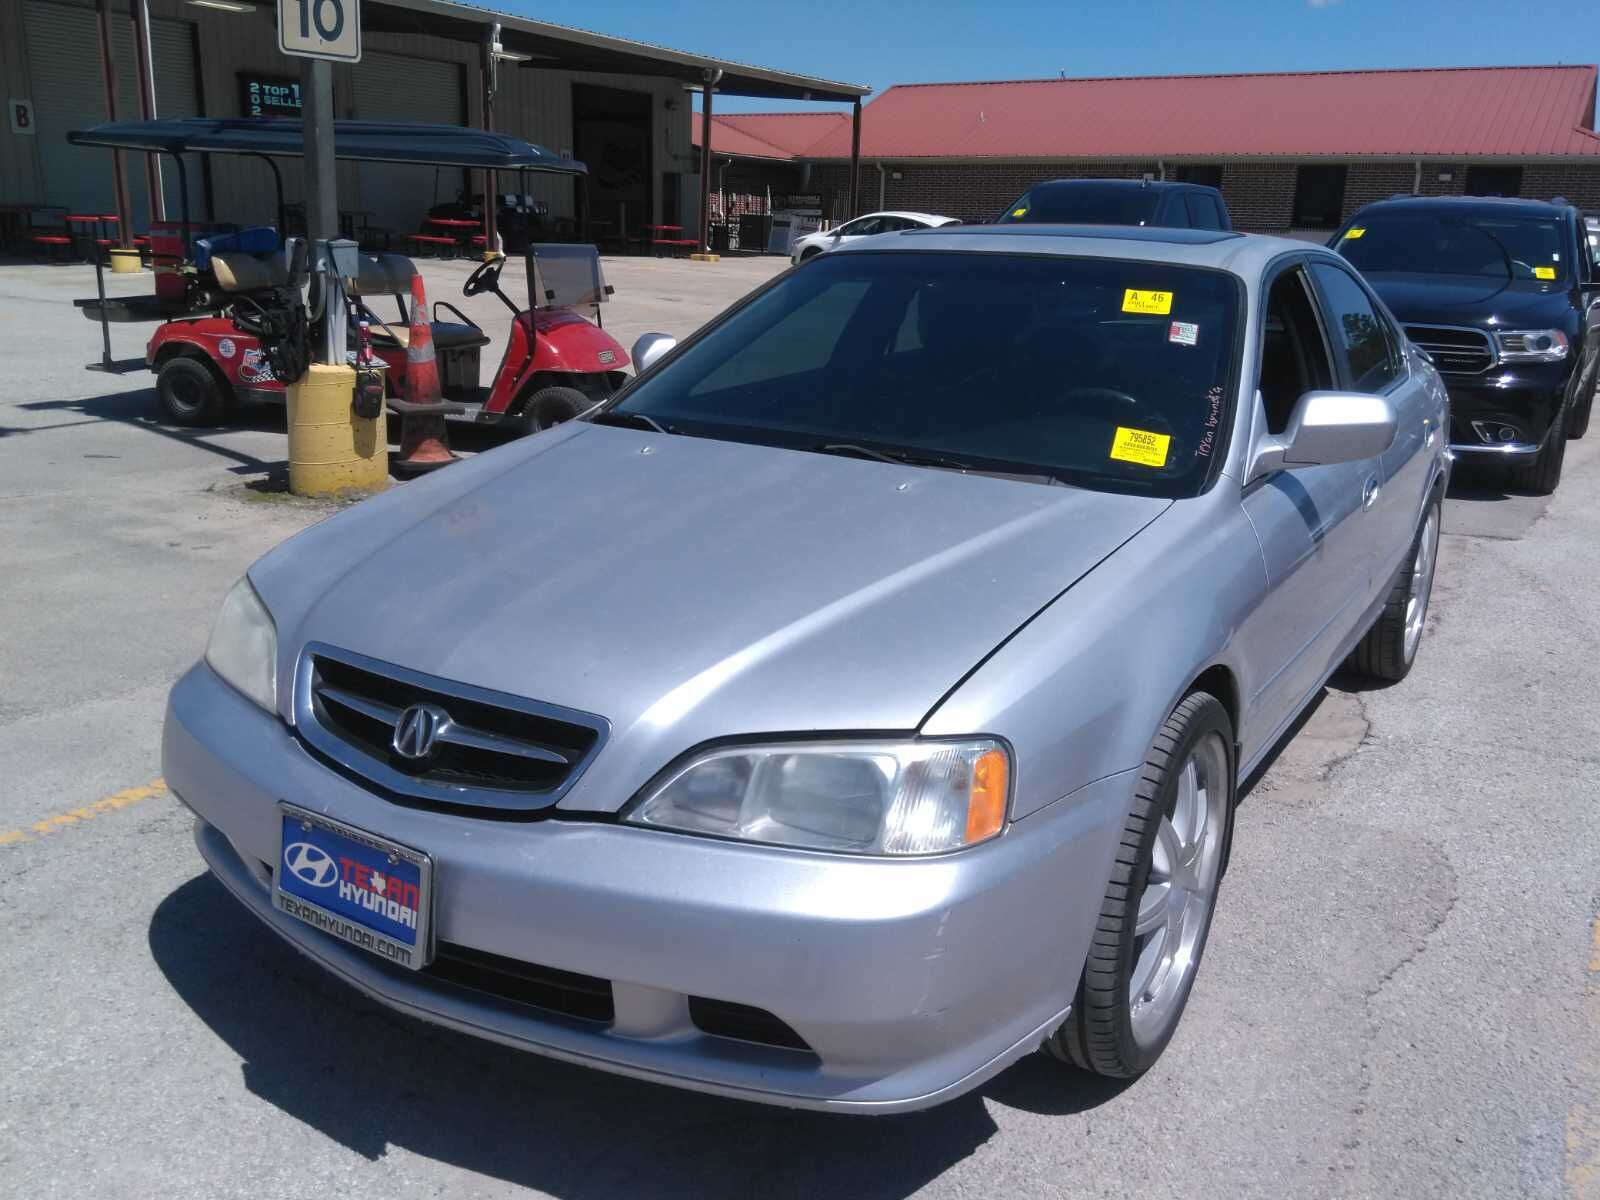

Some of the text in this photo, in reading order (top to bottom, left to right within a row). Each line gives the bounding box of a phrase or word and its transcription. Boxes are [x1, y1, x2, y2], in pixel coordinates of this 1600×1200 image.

[296, 0, 344, 42] 10
[263, 84, 289, 96] TOP
[263, 96, 303, 108] SELLE
[16, 104, 29, 128] B
[1130, 292, 1139, 301] A
[339, 880, 418, 929] HYUNDAI
